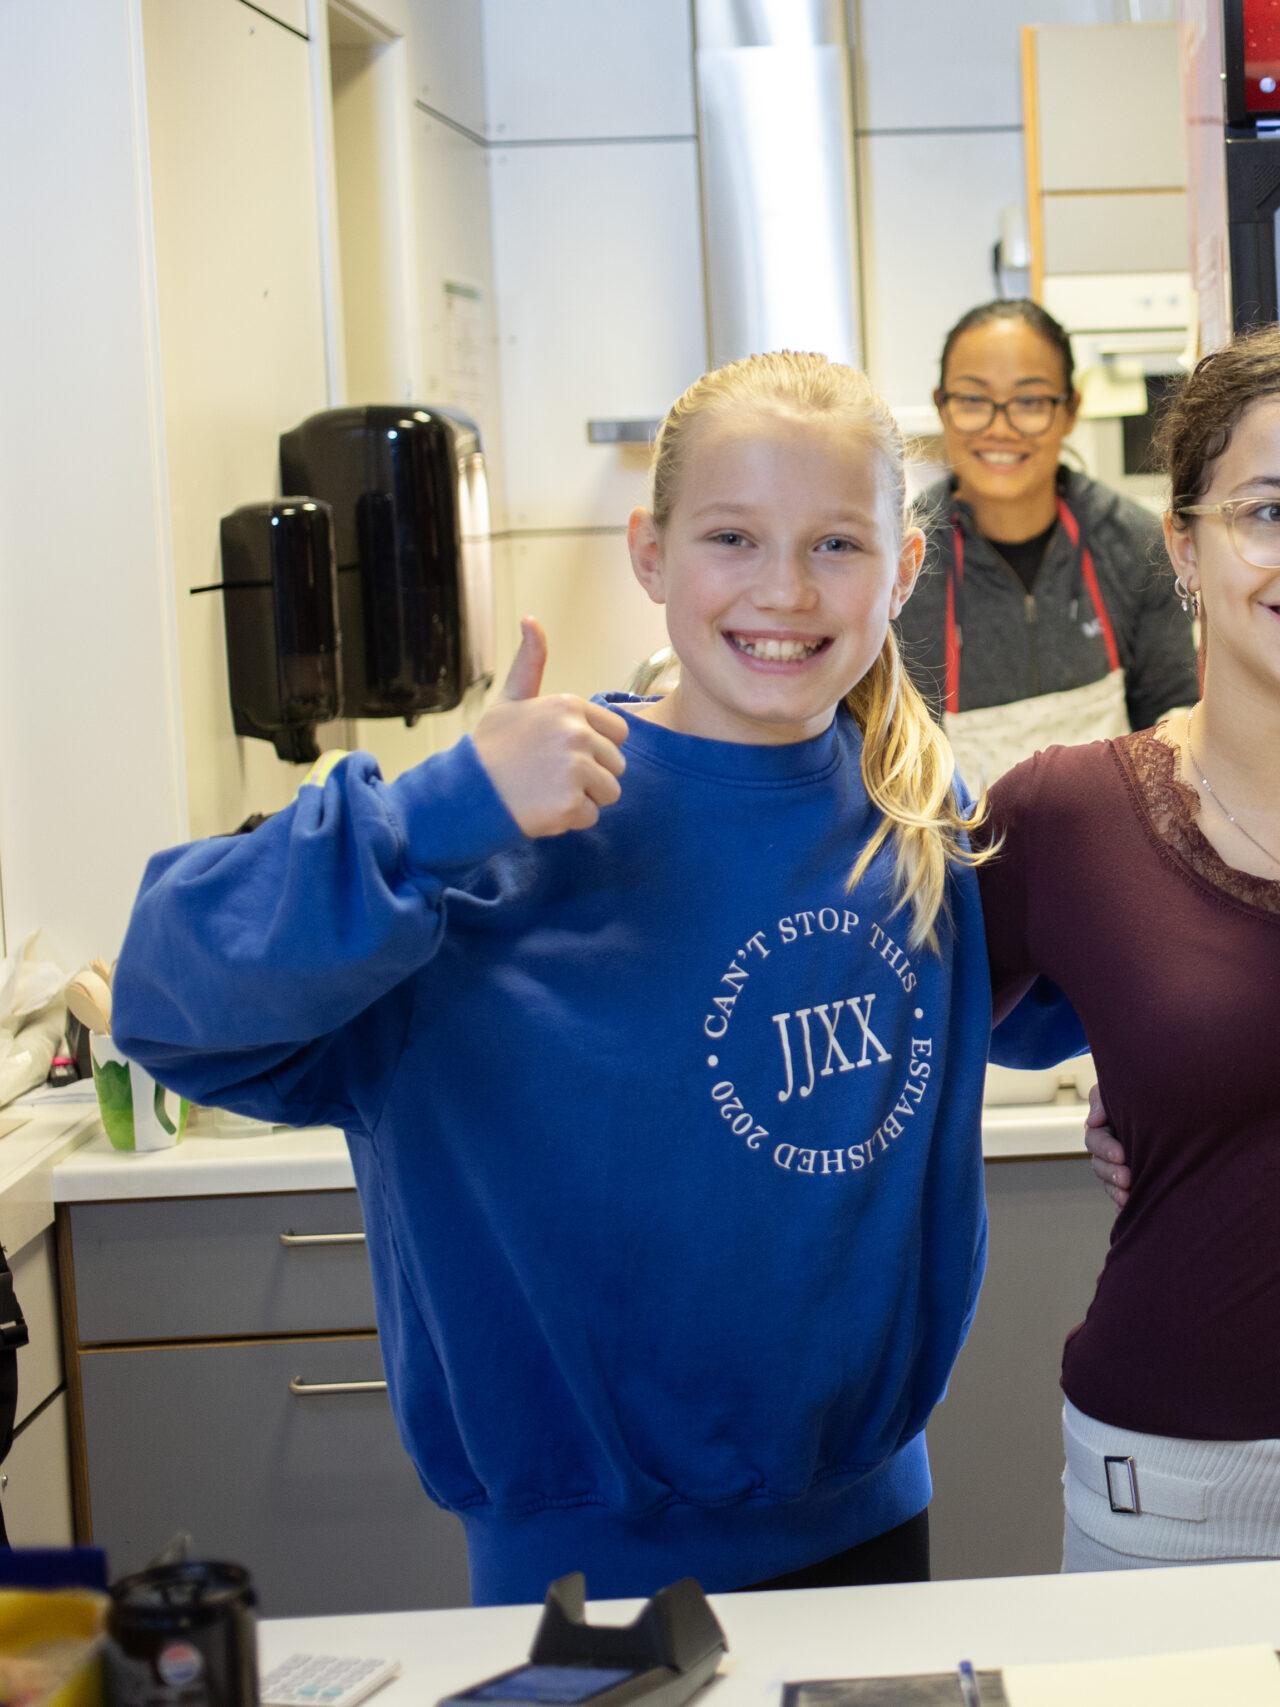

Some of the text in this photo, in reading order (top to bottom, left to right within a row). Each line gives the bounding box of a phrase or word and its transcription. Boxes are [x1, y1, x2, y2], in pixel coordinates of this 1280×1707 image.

[704, 907, 918, 1039] CAN'T STOP THIS
[711, 1037, 933, 1174] ESTABLISHED 2020
[772, 993, 893, 1102] JJXX
